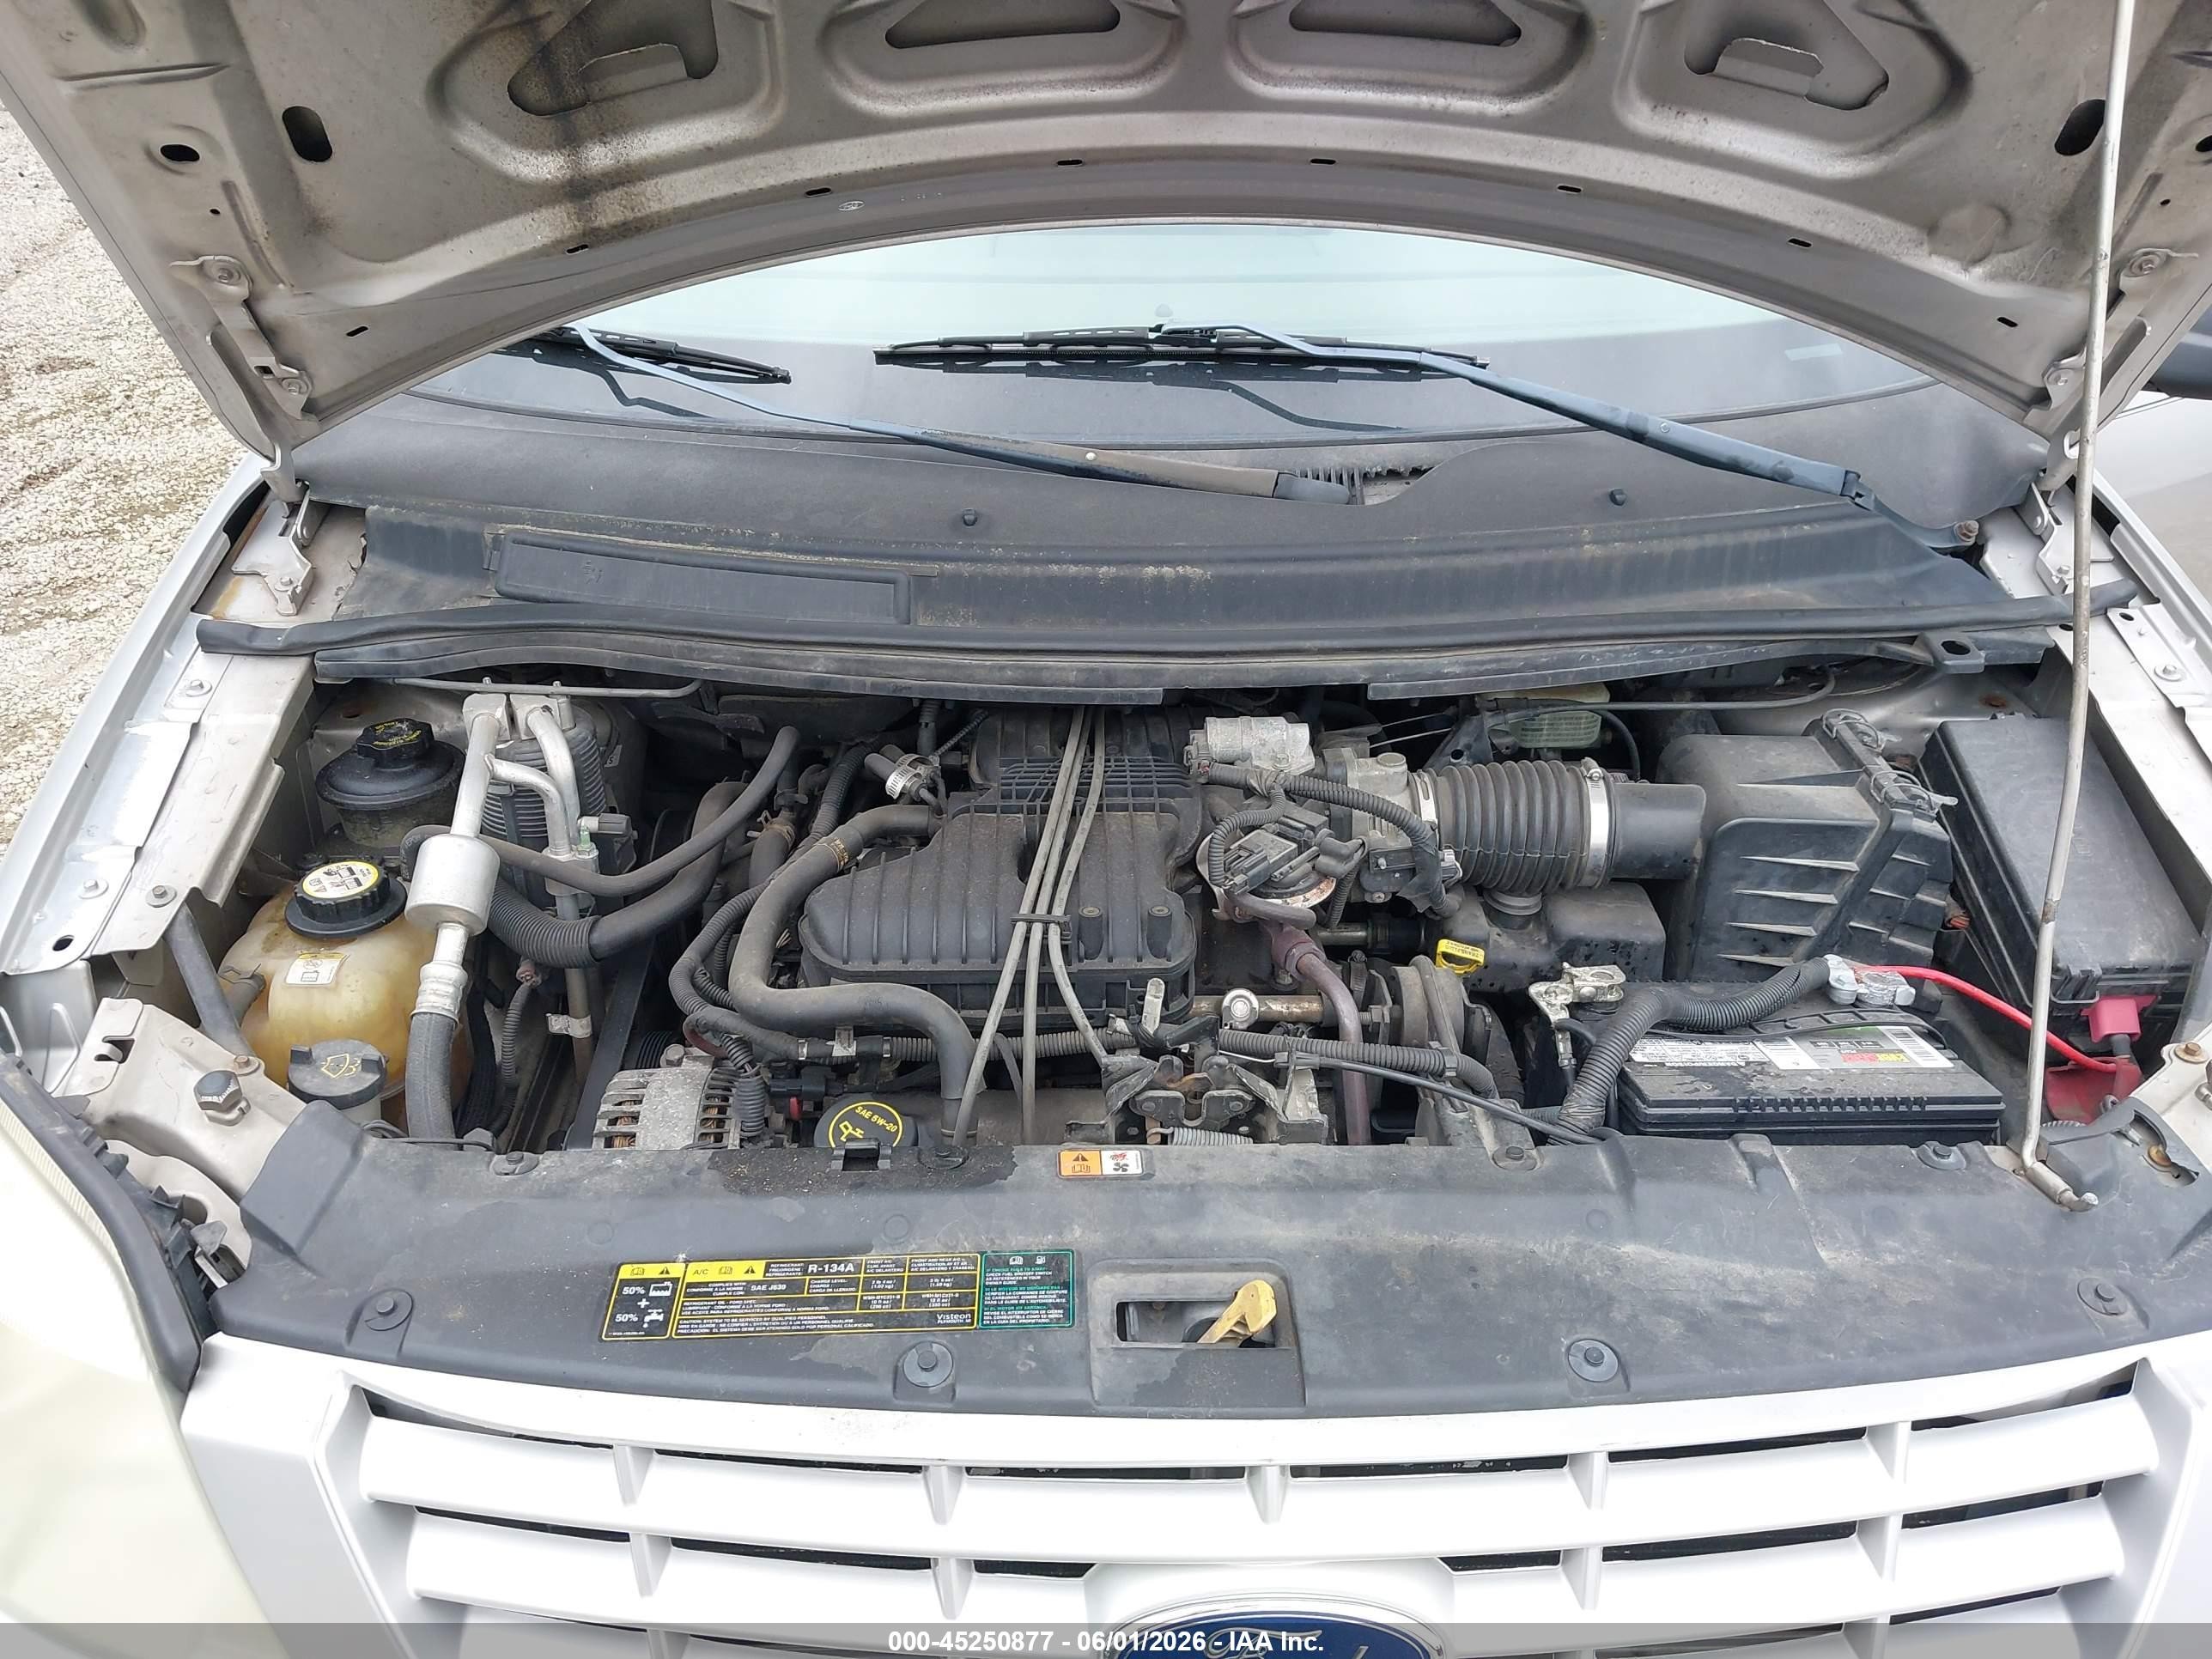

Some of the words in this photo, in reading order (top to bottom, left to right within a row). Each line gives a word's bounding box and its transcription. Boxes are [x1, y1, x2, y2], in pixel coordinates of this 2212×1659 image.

[854, 1106, 872, 1119] SAE
[871, 1114, 897, 1133] 5W-20
[807, 1262, 854, 1273] R-134A
[622, 1286, 646, 1295] 50%
[615, 1314, 639, 1322] 50%
